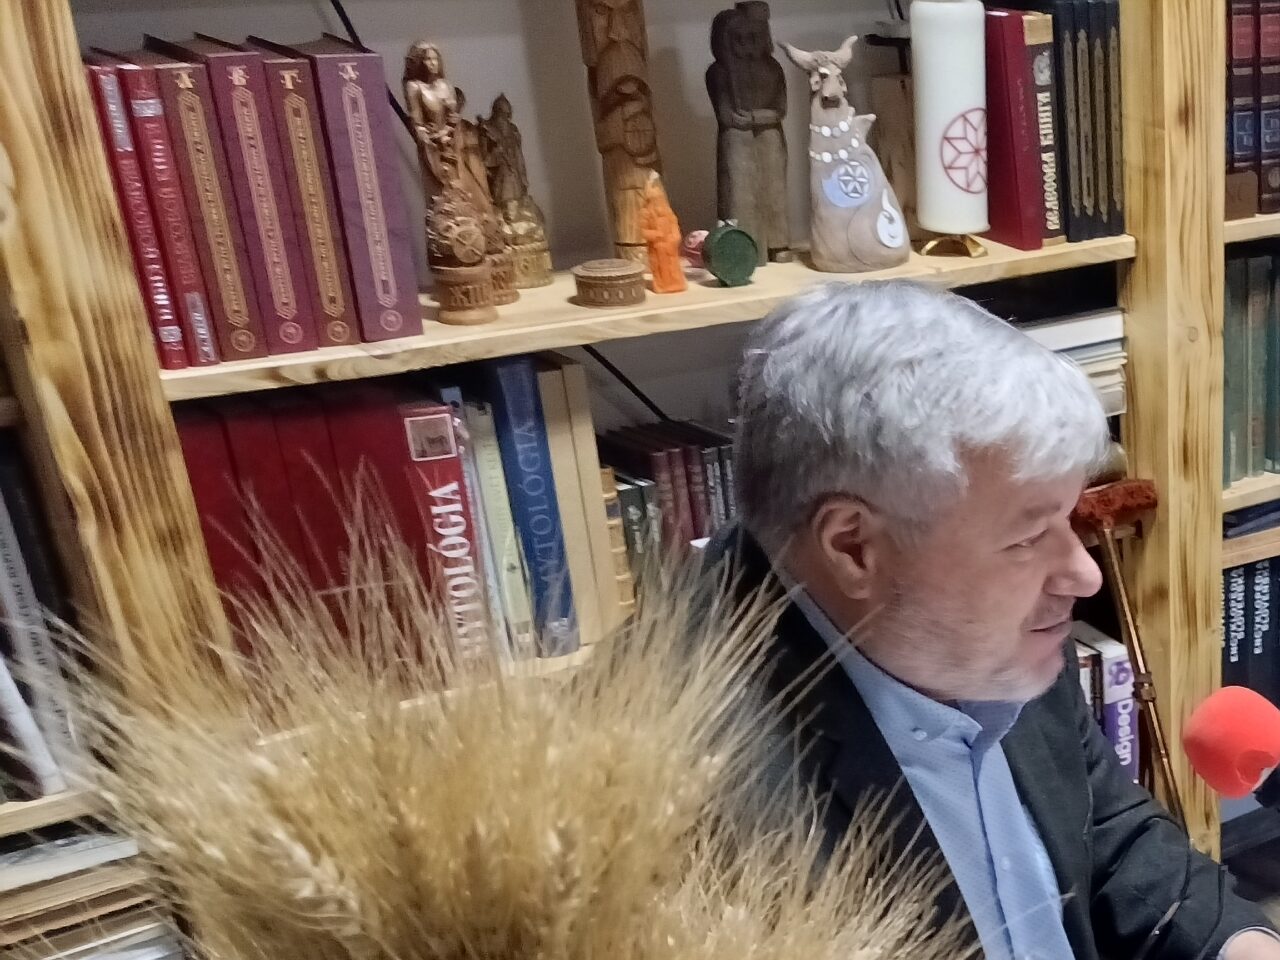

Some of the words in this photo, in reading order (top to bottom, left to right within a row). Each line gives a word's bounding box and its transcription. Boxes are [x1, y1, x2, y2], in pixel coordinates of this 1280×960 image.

[1036, 91, 1054, 147] КНИГА
[514, 421, 560, 597] MYTOLÓGIA
[426, 482, 484, 660] MYTOLÓGIA
[1114, 699, 1134, 766] Design
